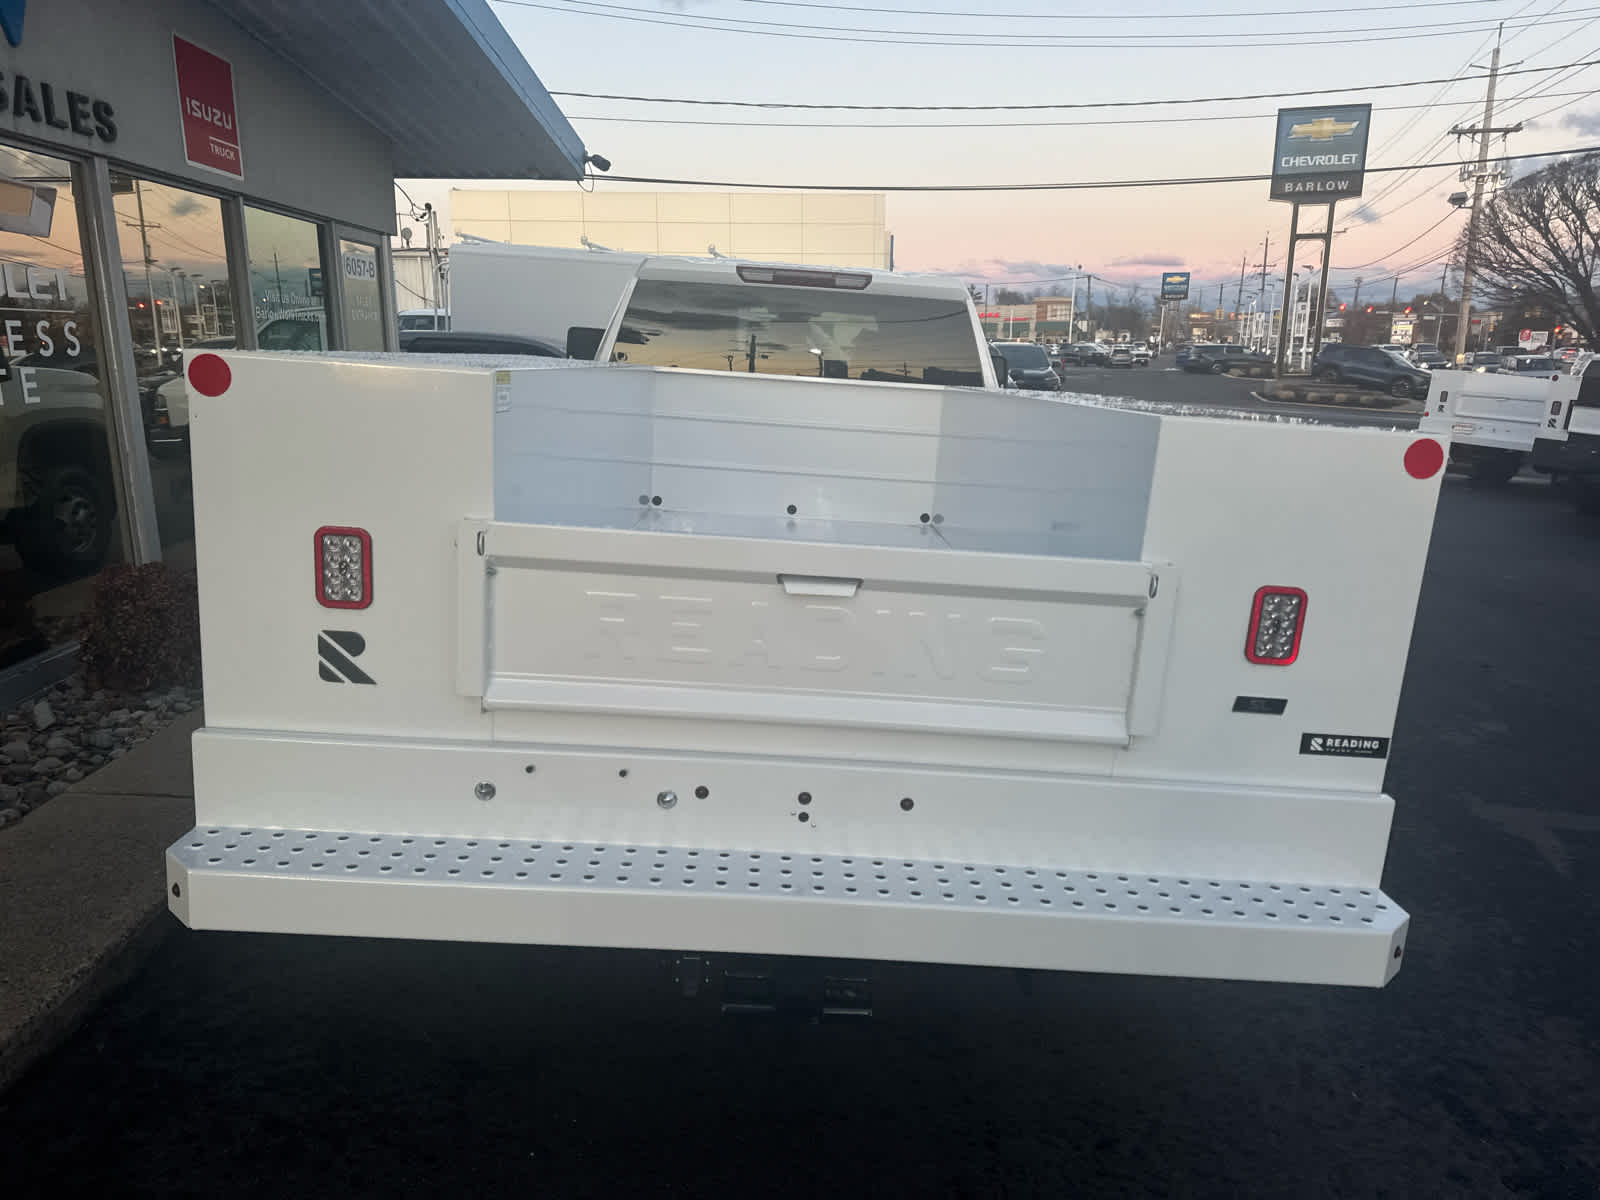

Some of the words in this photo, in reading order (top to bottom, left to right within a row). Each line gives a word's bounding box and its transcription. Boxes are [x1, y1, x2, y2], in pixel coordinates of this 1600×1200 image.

[186, 97, 232, 129] ISUZU
[209, 143, 235, 160] TRUCK
[1281, 153, 1358, 167] CHEVROLET
[1284, 180, 1349, 192] BARLOW
[345, 256, 375, 278] 6057-B
[1325, 738, 1380, 750] READING
